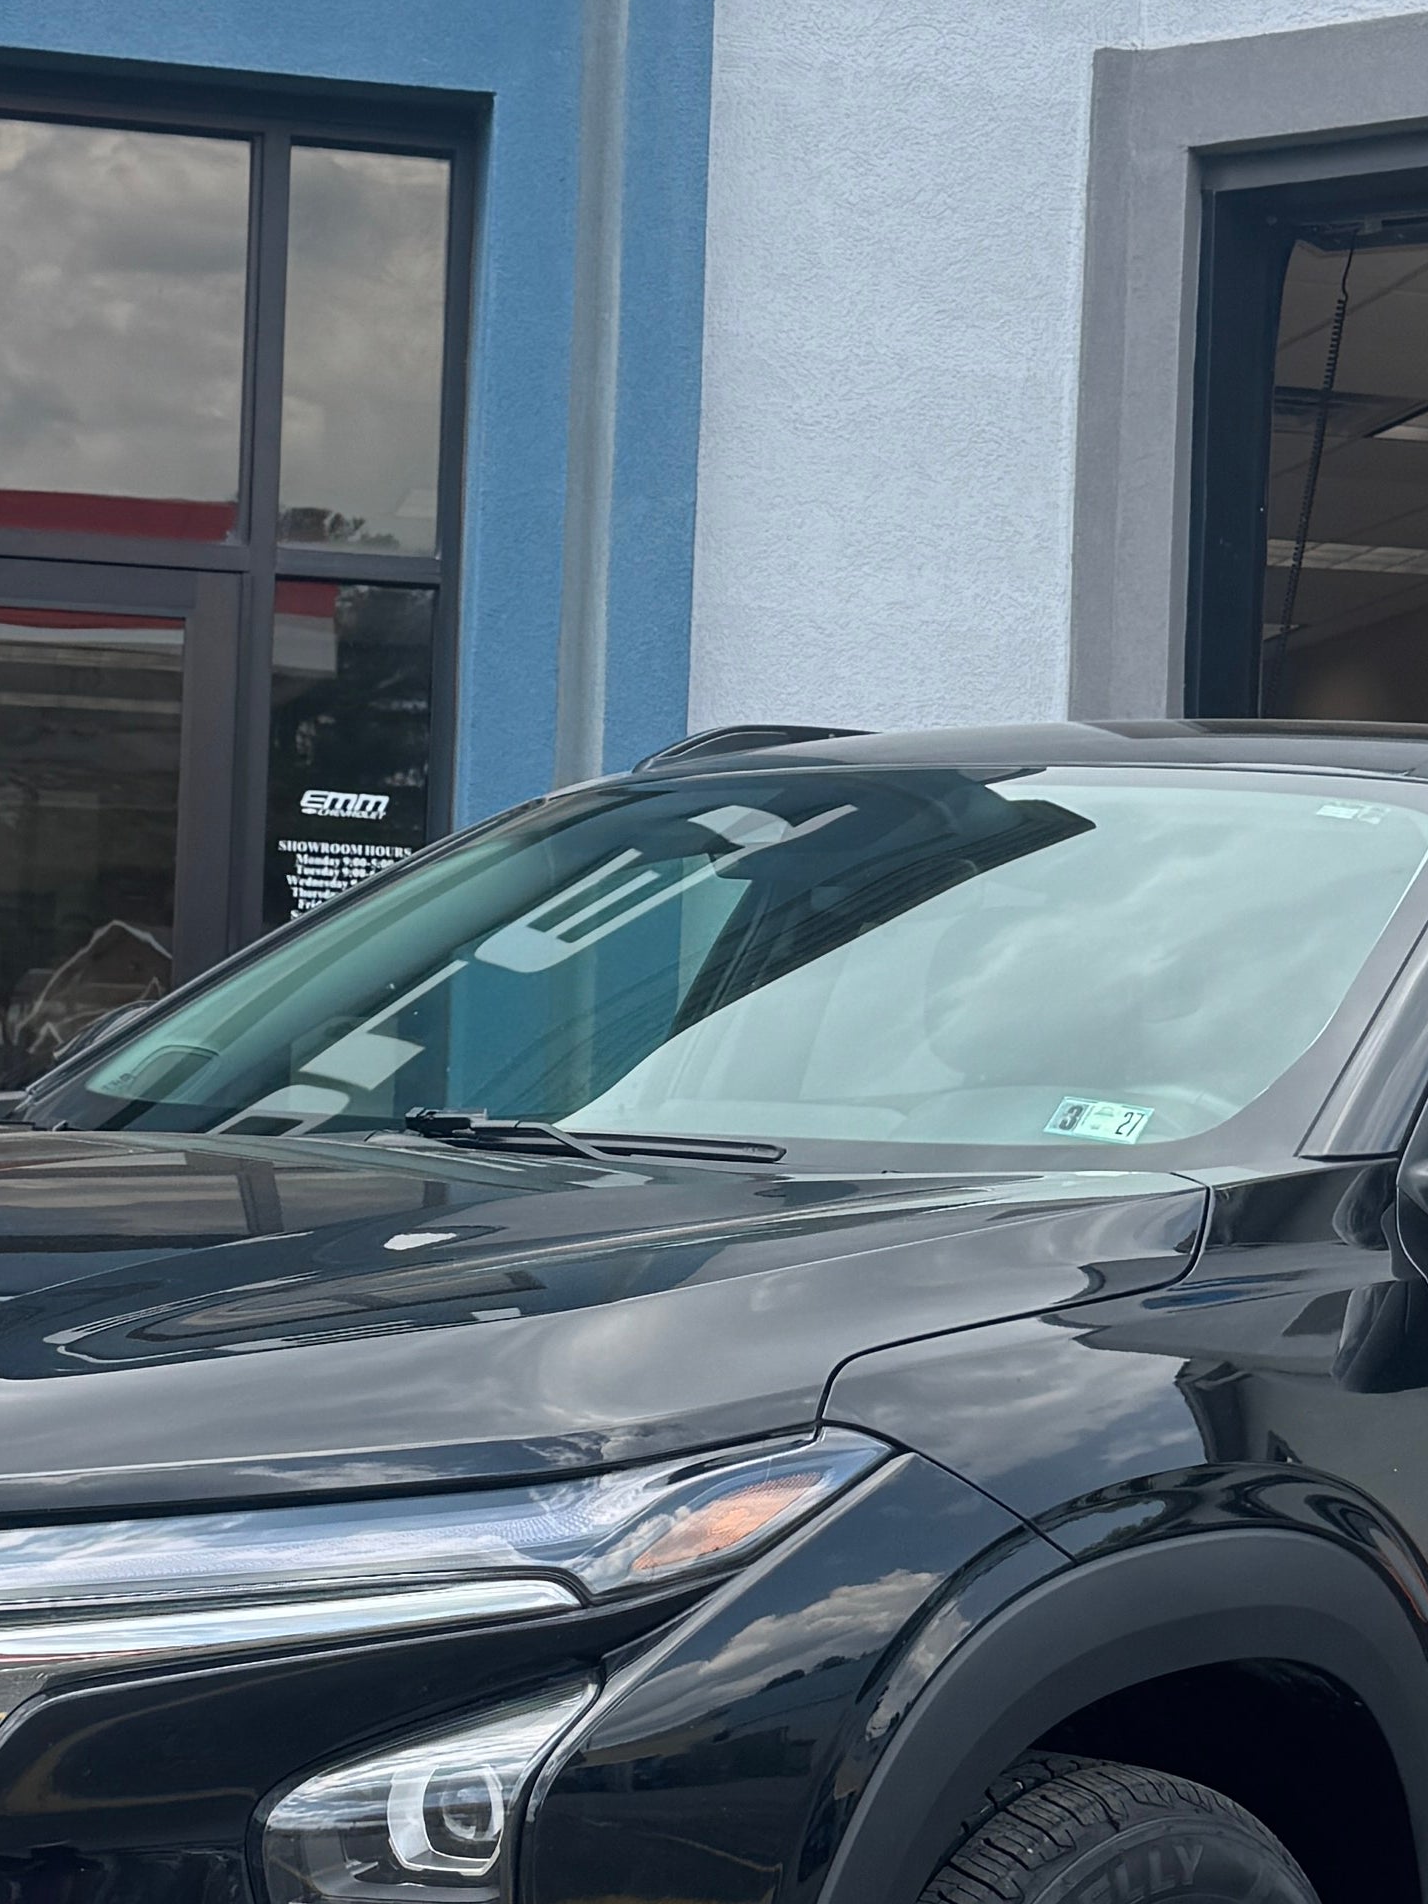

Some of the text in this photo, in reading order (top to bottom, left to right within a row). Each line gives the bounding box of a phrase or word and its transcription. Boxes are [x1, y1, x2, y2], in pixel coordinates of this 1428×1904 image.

[278, 840, 412, 858] SHOWROOM HOURS
[296, 853, 341, 868] Monday
[296, 864, 340, 879] Tuesday
[286, 874, 348, 891] Wednesday
[291, 886, 337, 900] Thursda
[1114, 1111, 1146, 1137] 27
